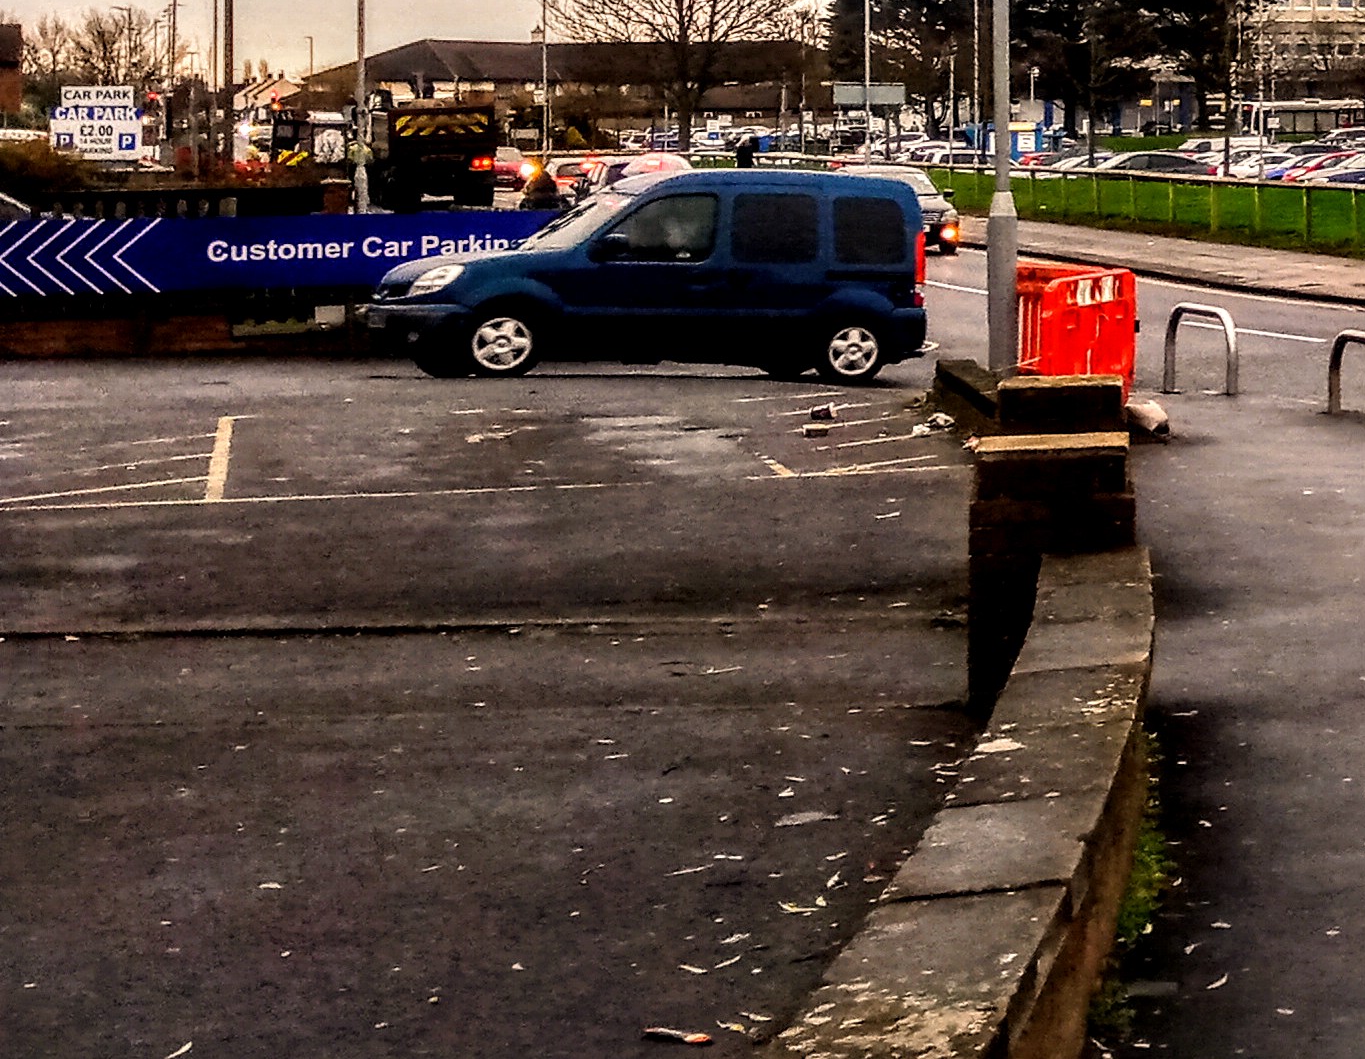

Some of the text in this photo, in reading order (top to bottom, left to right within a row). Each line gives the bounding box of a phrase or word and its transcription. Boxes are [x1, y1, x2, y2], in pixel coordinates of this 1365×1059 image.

[63, 89, 131, 101] CAR PARK
[54, 106, 138, 121] CAR PARK
[80, 124, 113, 137] £2.00
[121, 135, 132, 149] P
[207, 238, 354, 263] Customer
[361, 236, 413, 258] Car
